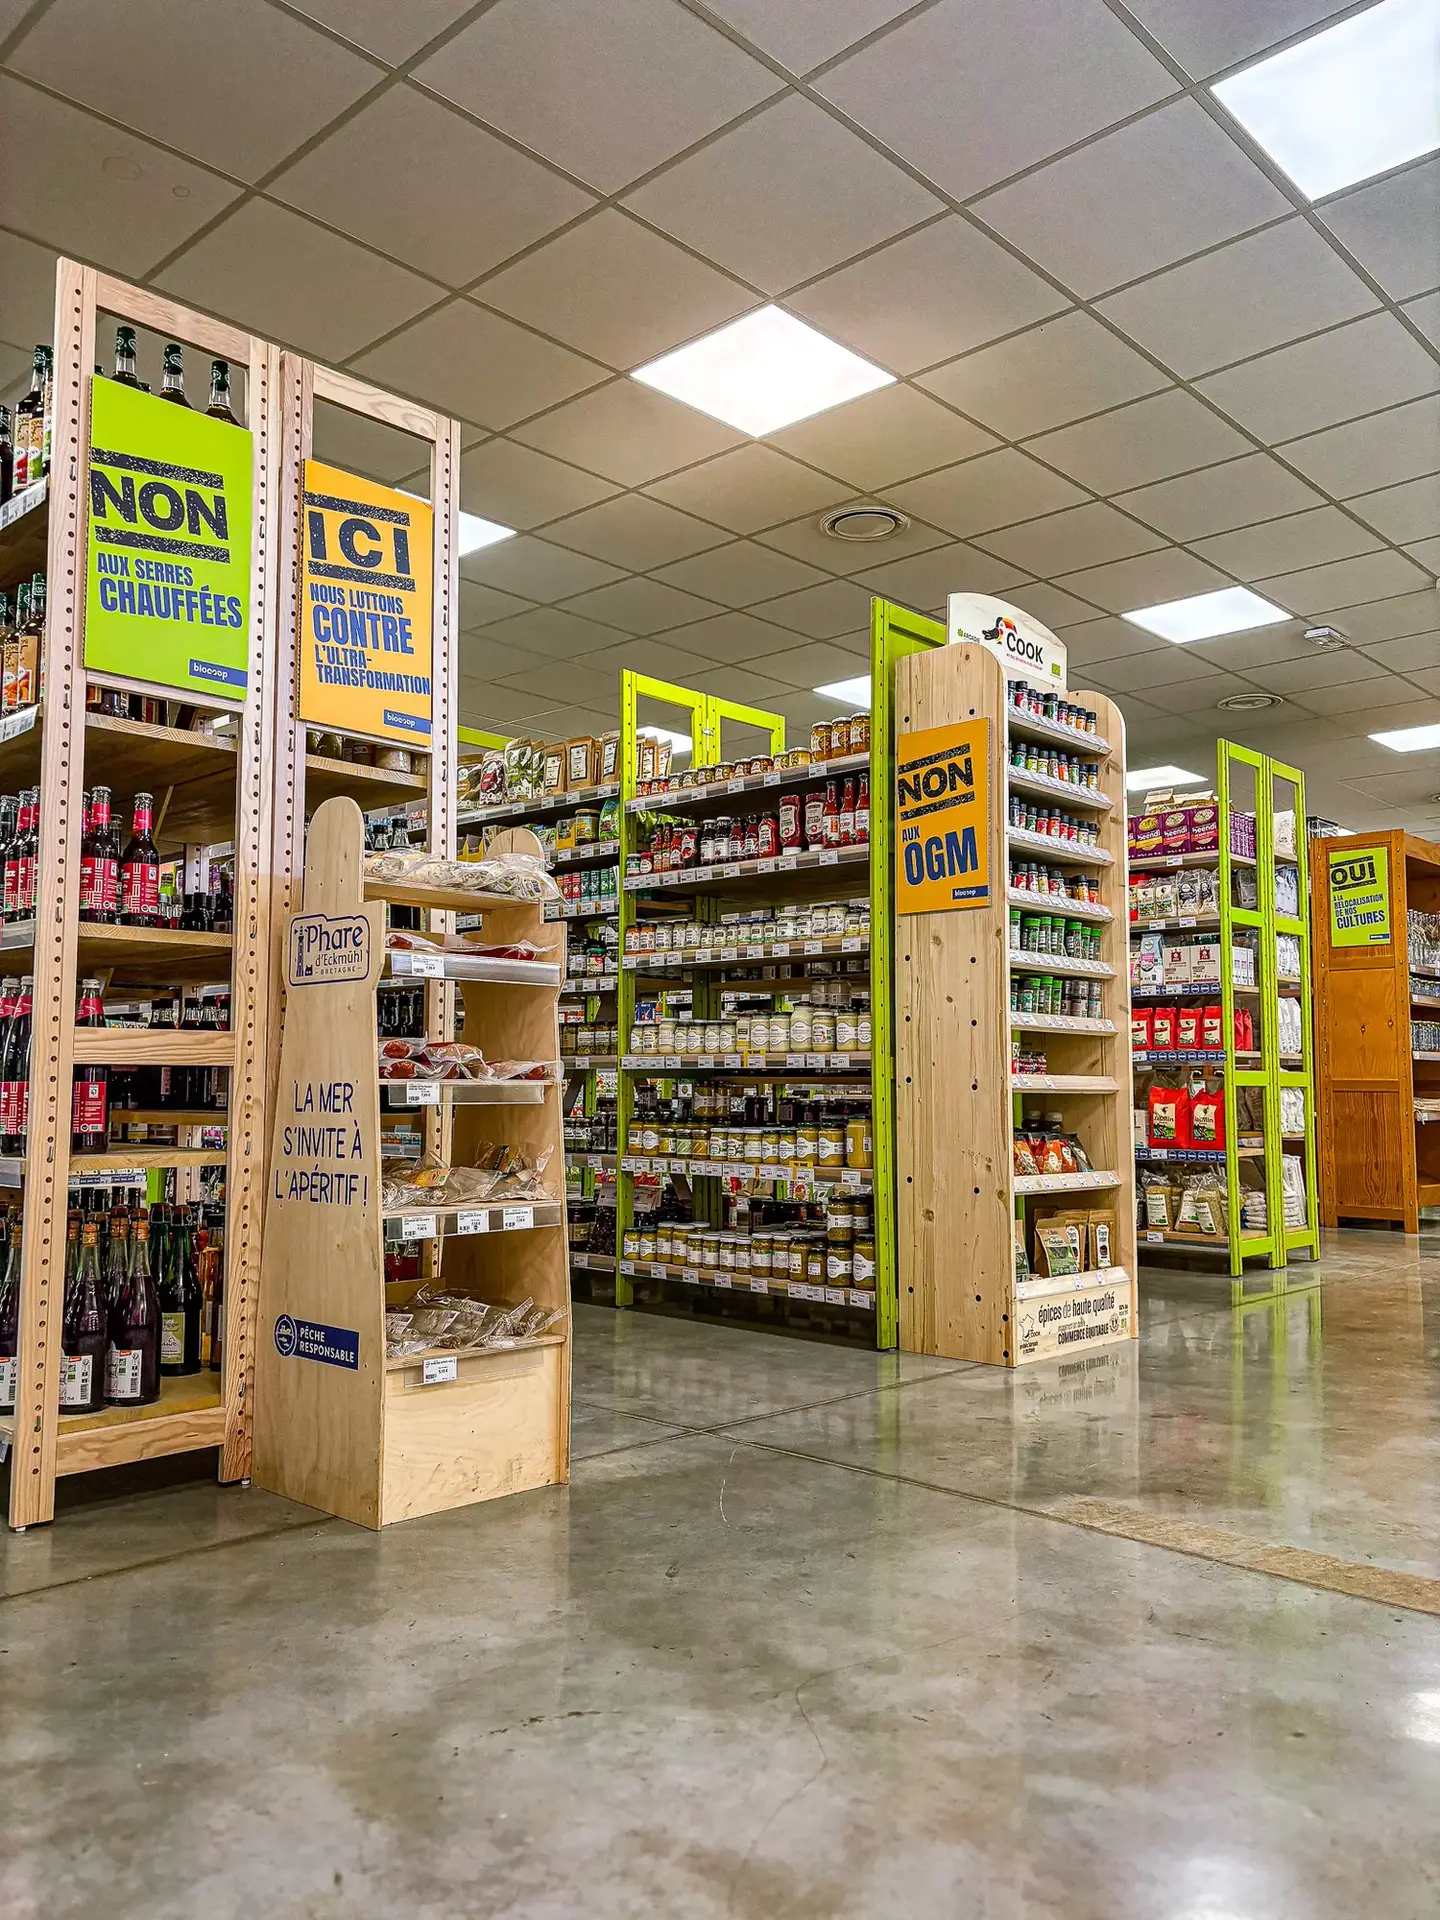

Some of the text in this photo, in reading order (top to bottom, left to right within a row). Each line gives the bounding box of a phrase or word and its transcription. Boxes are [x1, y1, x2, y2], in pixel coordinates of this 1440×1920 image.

[90, 469, 229, 541] NON
[307, 510, 411, 576] ICI
[97, 552, 194, 587] AUX SERRES
[99, 577, 244, 629] CHAUFFÉES
[310, 583, 404, 616] NOUS LUTTONS
[312, 605, 415, 655] CONTRE
[315, 645, 373, 669] L'ULTRA-
[1006, 632, 1044, 664] COOK
[192, 662, 229, 681] biocoop
[316, 664, 431, 696] TRANSFORMATION
[387, 712, 416, 728] biocoop
[898, 757, 974, 807] NON
[902, 825, 920, 842] AUX
[904, 826, 979, 886] OGM
[1331, 862, 1376, 885] OUI
[954, 888, 976, 898] biocoop
[1334, 893, 1385, 909] RELOCALISATION
[1335, 906, 1358, 918] DE NOS
[1336, 909, 1386, 929] CULTURES
[305, 924, 364, 953] Phare
[315, 950, 363, 967] d'Eckmühl
[320, 966, 356, 976] BRETAGNE
[294, 1082, 354, 1113] LA MER
[283, 1119, 363, 1160] S'INVITE À
[275, 1163, 359, 1206] L'APÉRITIF
[1038, 1304, 1062, 1328] épices
[1063, 1301, 1072, 1319] de
[1072, 1298, 1092, 1317] haute
[1092, 1292, 1115, 1317] qualité
[299, 1326, 325, 1342] PÊCHE
[1058, 1327, 1086, 1345] COMMERCE
[1085, 1323, 1109, 1339] ÉQUITABLE
[299, 1341, 355, 1363] RESPONSABLE
